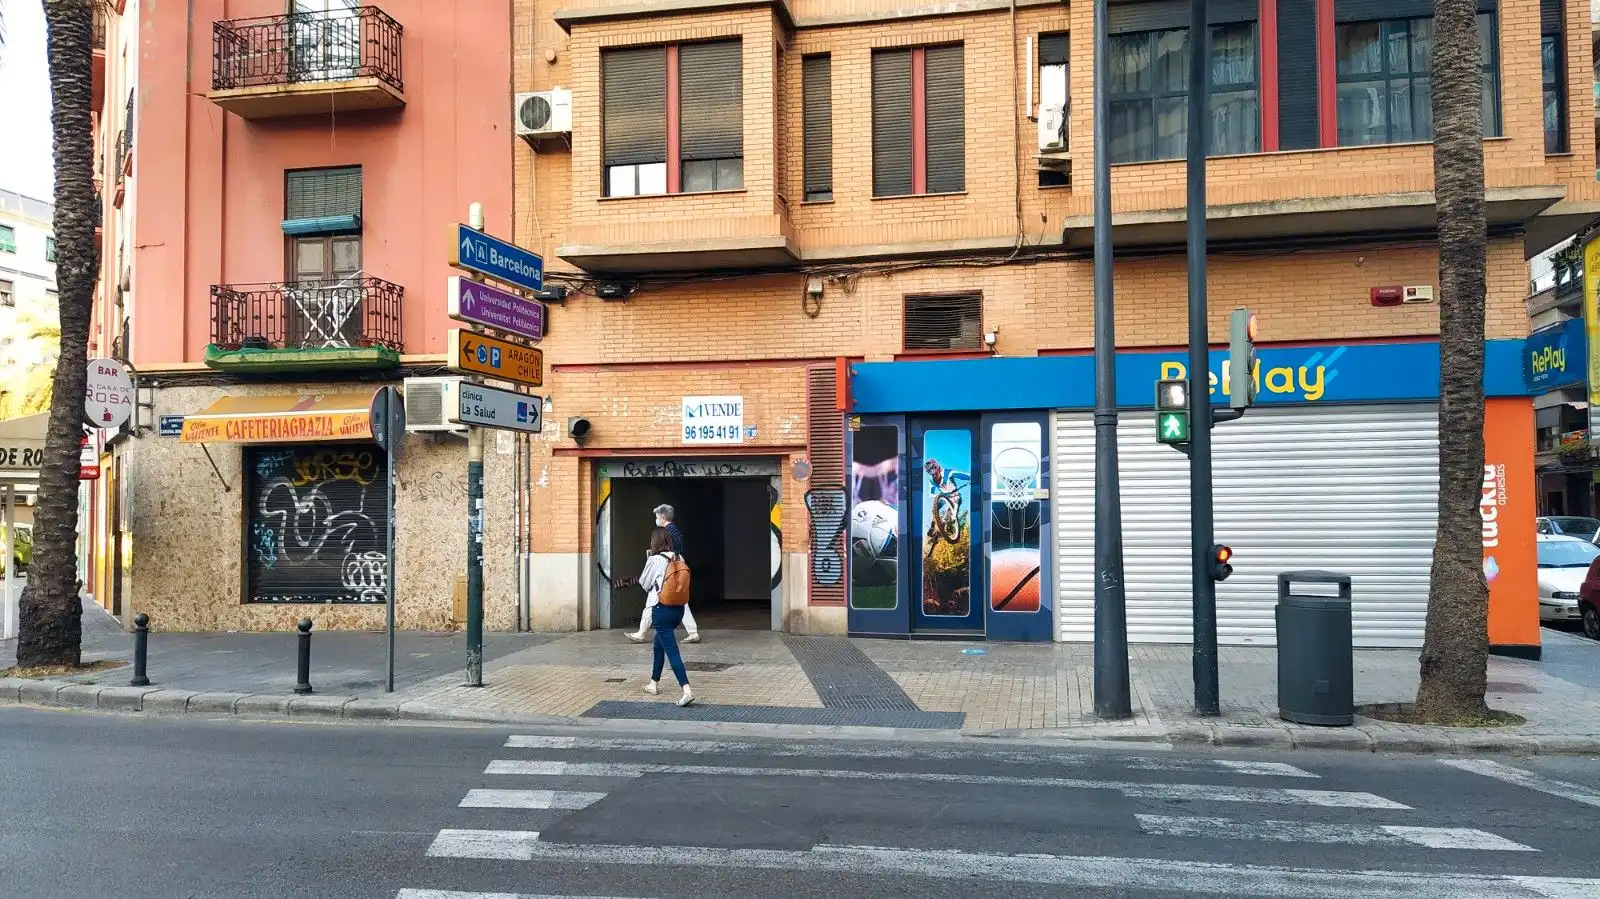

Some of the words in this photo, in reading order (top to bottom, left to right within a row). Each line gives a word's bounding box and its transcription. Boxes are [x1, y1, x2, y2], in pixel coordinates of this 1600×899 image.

[490, 247, 540, 281] Barcelona
[480, 290, 511, 310] Universidad
[481, 307, 511, 324] Universitat
[508, 349, 540, 366] ARAGÓN
[1532, 345, 1566, 375] RePlay
[97, 366, 118, 377] BAR
[517, 366, 540, 379] CHILE
[462, 389, 483, 402] clínica
[462, 403, 471, 415] La
[474, 405, 496, 419] Salud
[704, 403, 742, 417] VENDE
[685, 425, 697, 439] 96
[698, 425, 715, 439] 195
[717, 425, 726, 439] 41
[729, 425, 739, 439] 91
[23, 447, 44, 467] RO
[1498, 463, 1508, 506] apuestas
